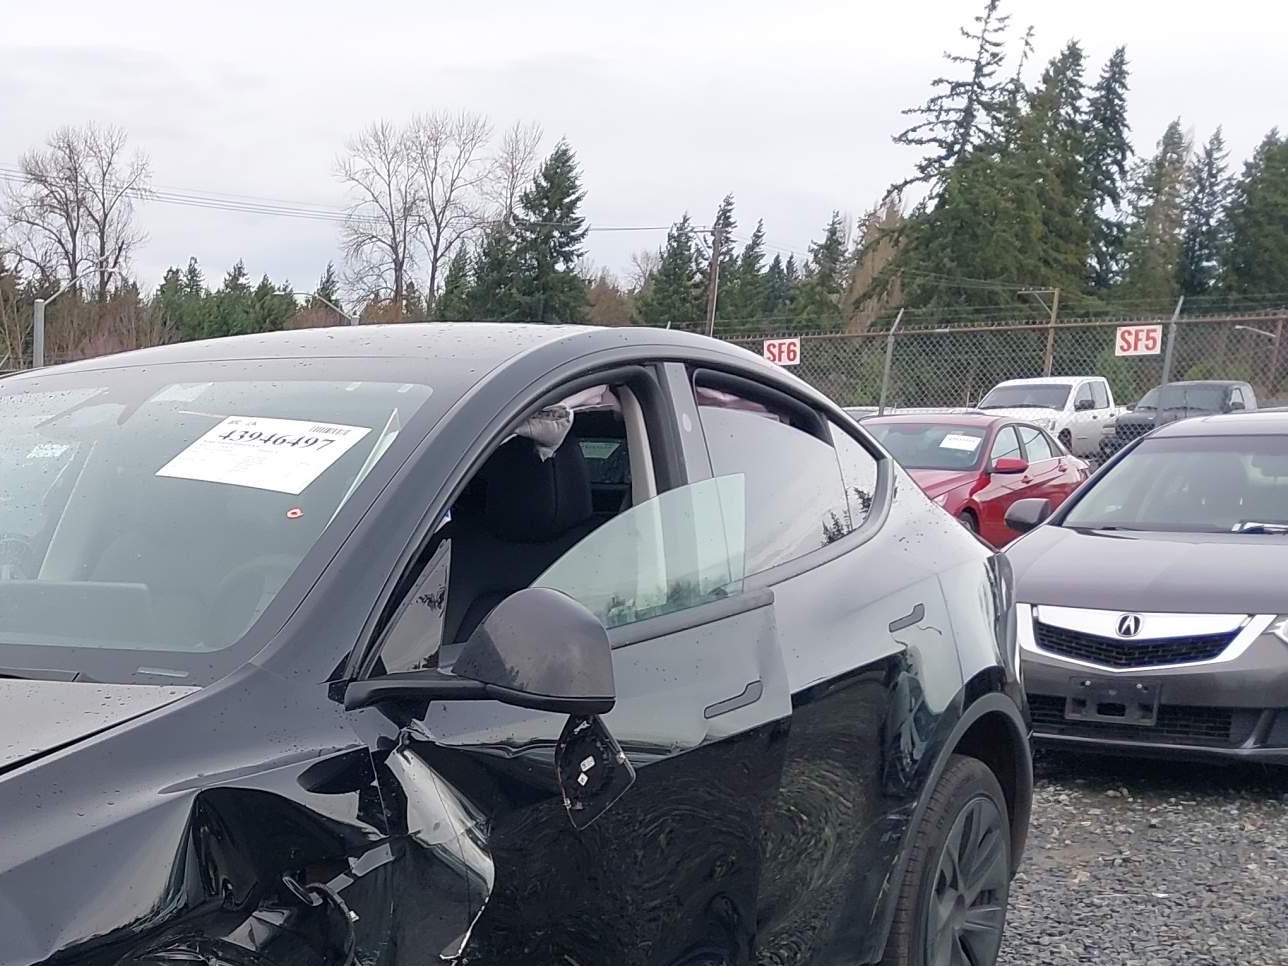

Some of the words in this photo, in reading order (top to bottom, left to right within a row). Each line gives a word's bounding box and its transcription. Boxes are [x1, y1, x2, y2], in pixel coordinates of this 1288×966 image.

[766, 341, 798, 362] SF6
[1119, 329, 1158, 352] SF5
[218, 429, 336, 451] 43946497
